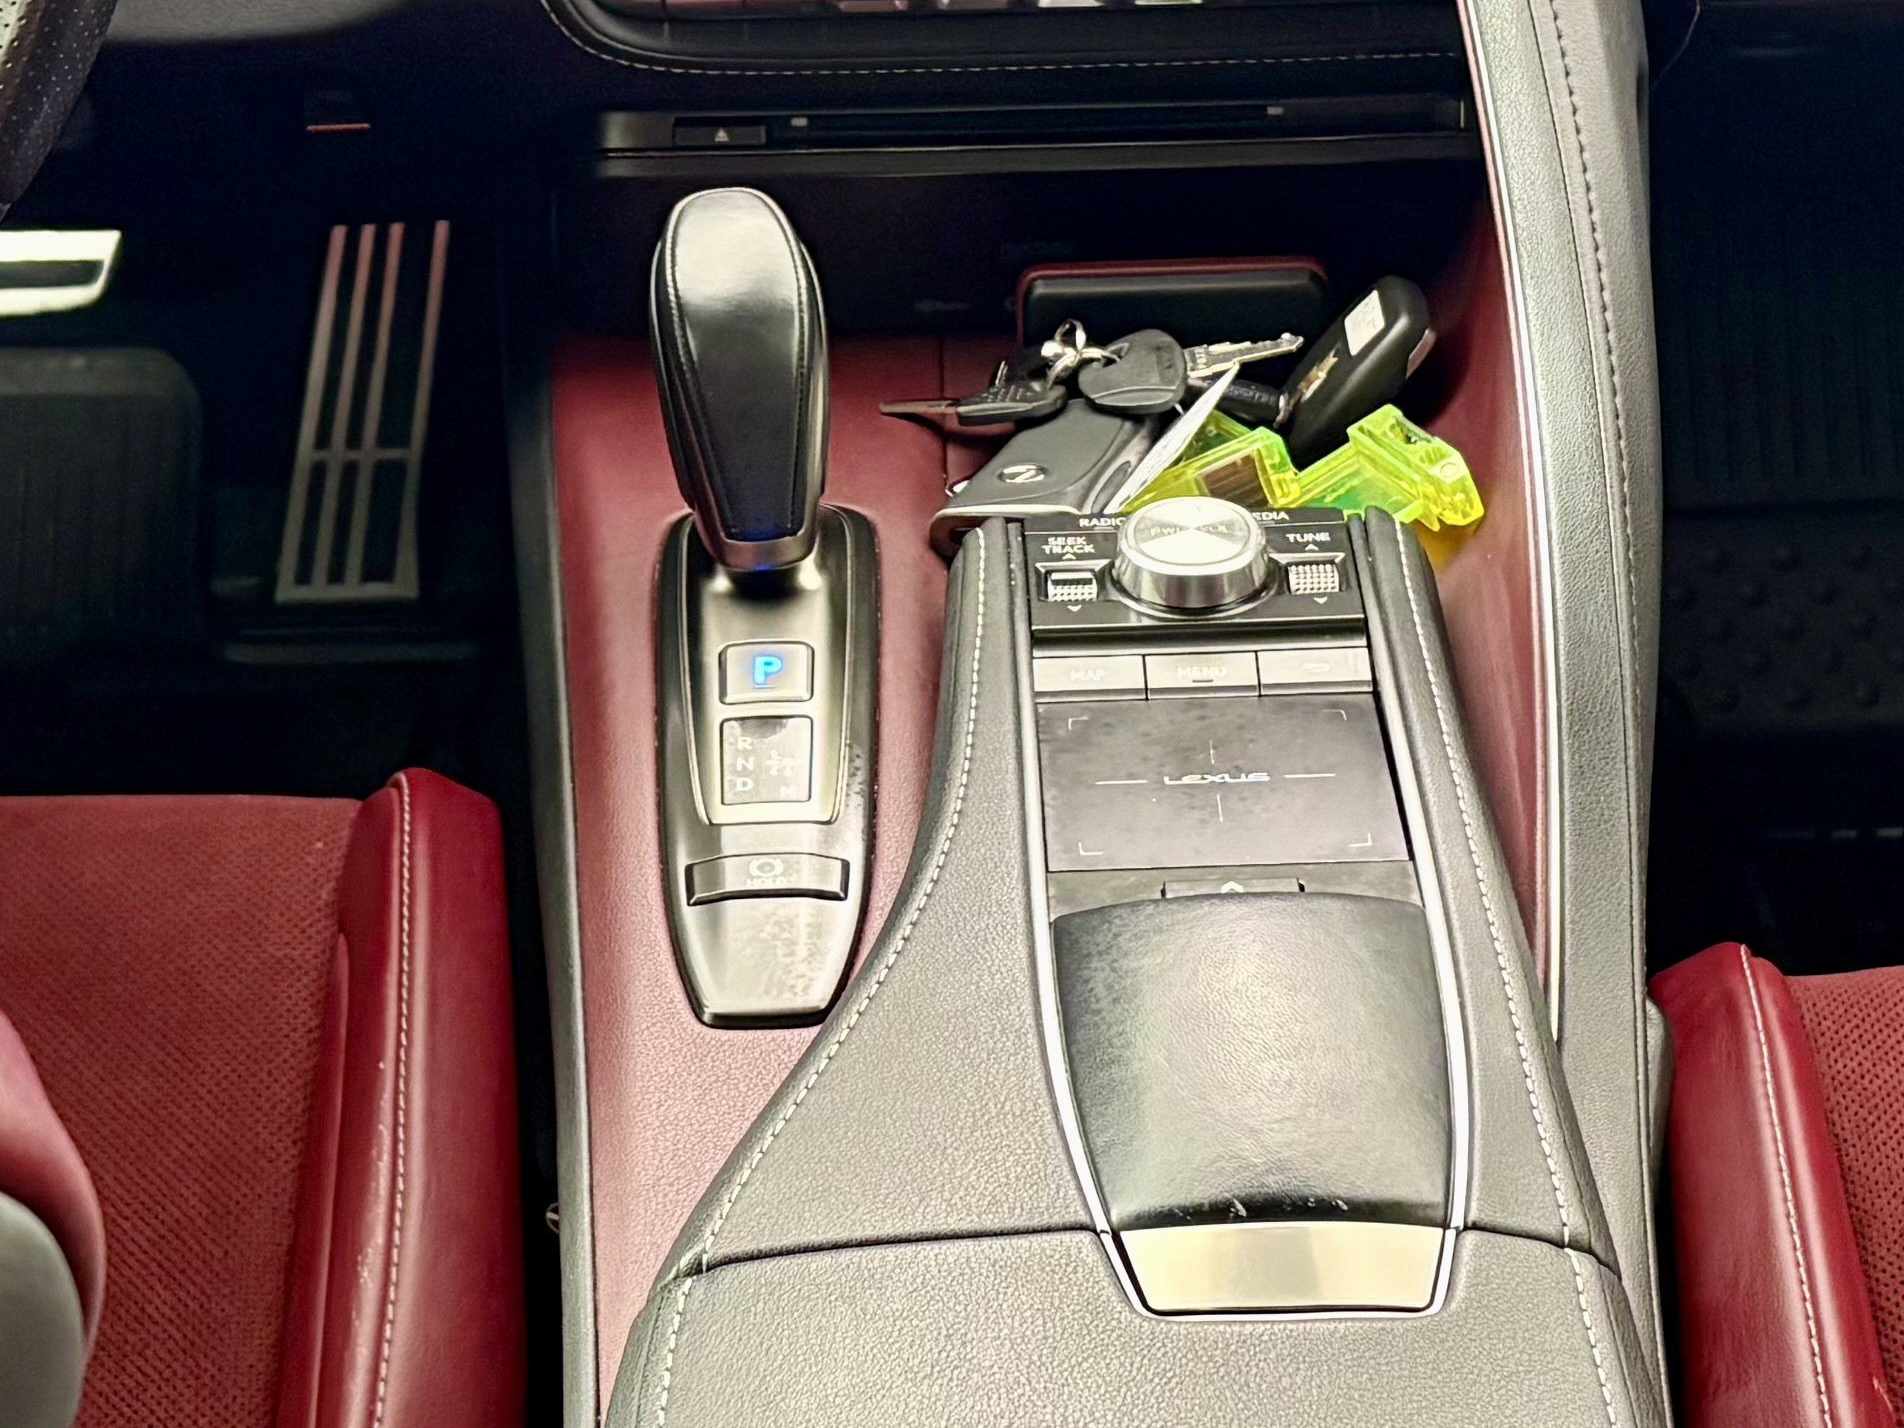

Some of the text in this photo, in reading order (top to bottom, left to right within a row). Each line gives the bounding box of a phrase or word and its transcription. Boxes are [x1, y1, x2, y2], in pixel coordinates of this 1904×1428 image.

[1251, 510, 1290, 522] EDIA
[1047, 536, 1087, 546] SEEK
[1285, 531, 1331, 543] TUNE
[1041, 543, 1096, 555] TRACK
[753, 654, 784, 686] P
[1070, 665, 1228, 682] MAP MENU
[736, 736, 753, 751] R
[736, 756, 755, 772] N
[736, 776, 754, 792] D
[1163, 771, 1271, 786] LEXUS
